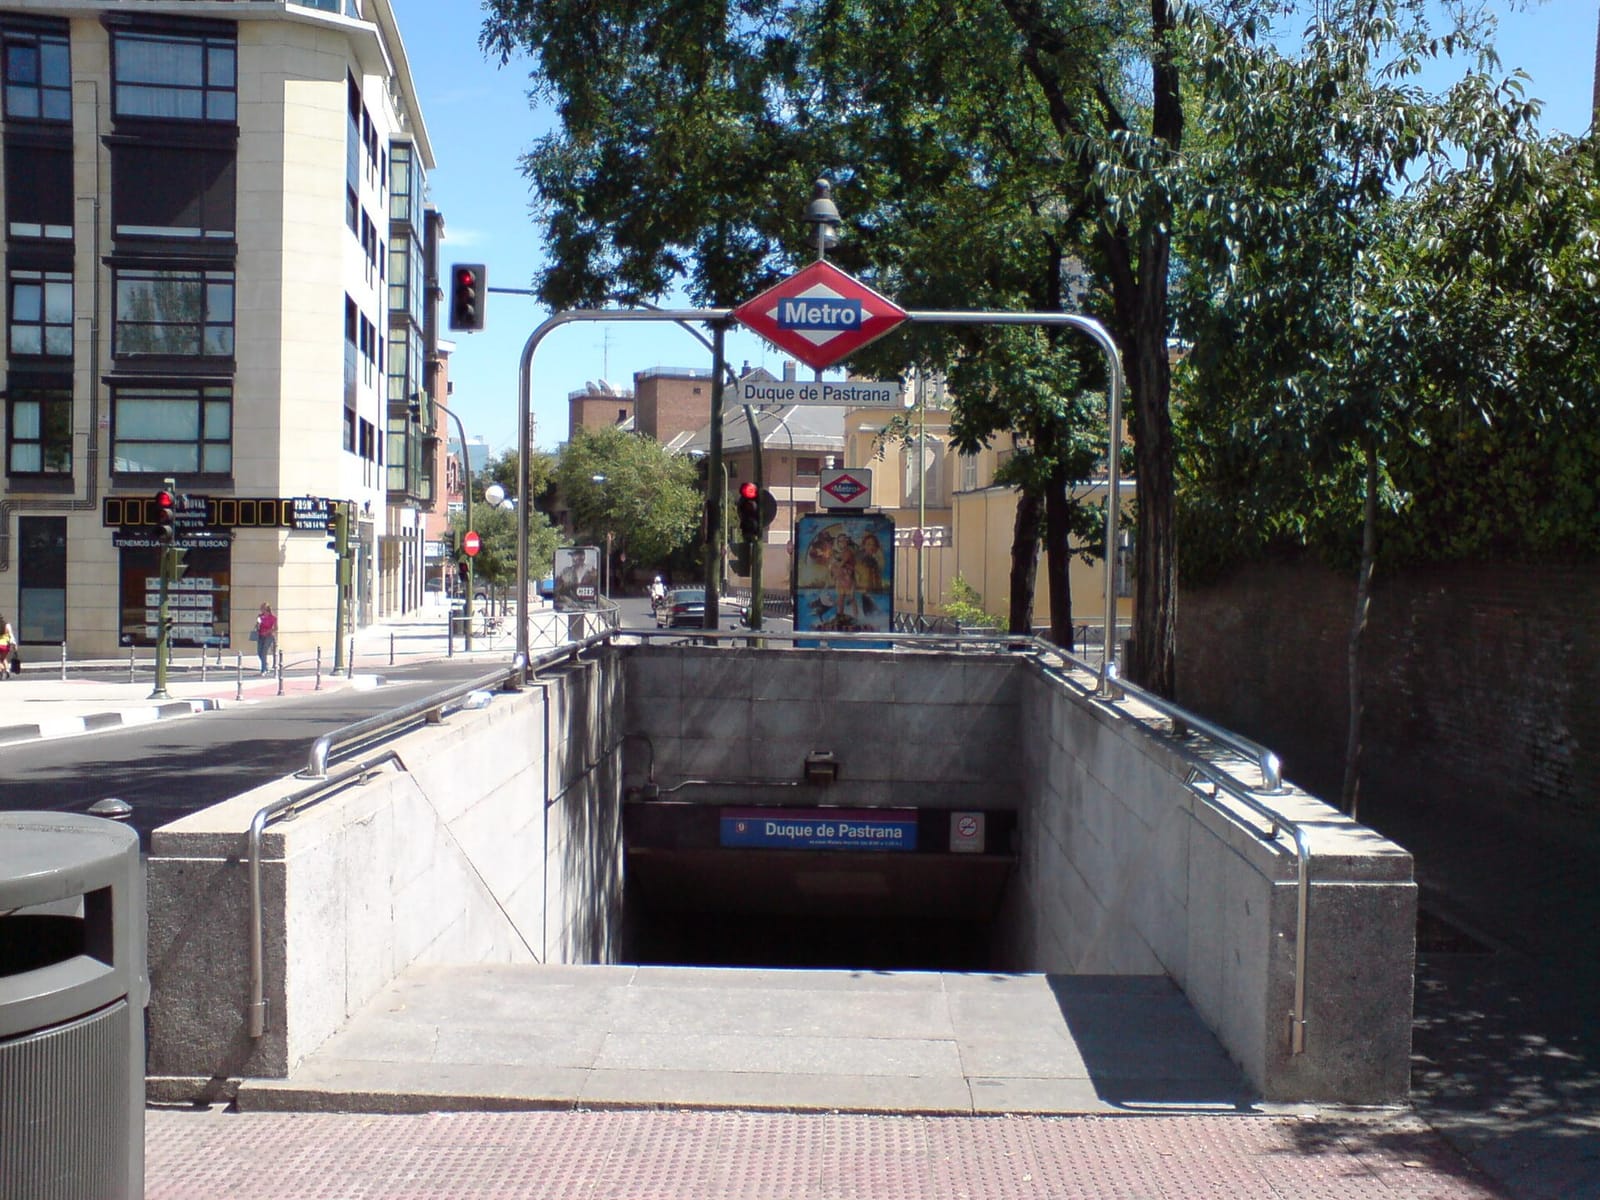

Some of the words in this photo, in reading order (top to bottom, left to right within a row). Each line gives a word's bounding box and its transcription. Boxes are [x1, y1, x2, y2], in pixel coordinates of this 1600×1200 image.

[785, 302, 856, 325] Metro
[744, 384, 794, 403] Duque
[799, 385, 818, 400] de
[823, 386, 890, 402] Pastrana
[833, 485, 857, 493] Metro
[115, 539, 150, 548] TENEMOS
[150, 540, 160, 548] LA
[182, 540, 197, 548] QUE
[576, 586, 595, 597] CHE
[765, 822, 813, 839] Duque
[816, 823, 835, 838] de
[838, 824, 903, 839] Pastrana
